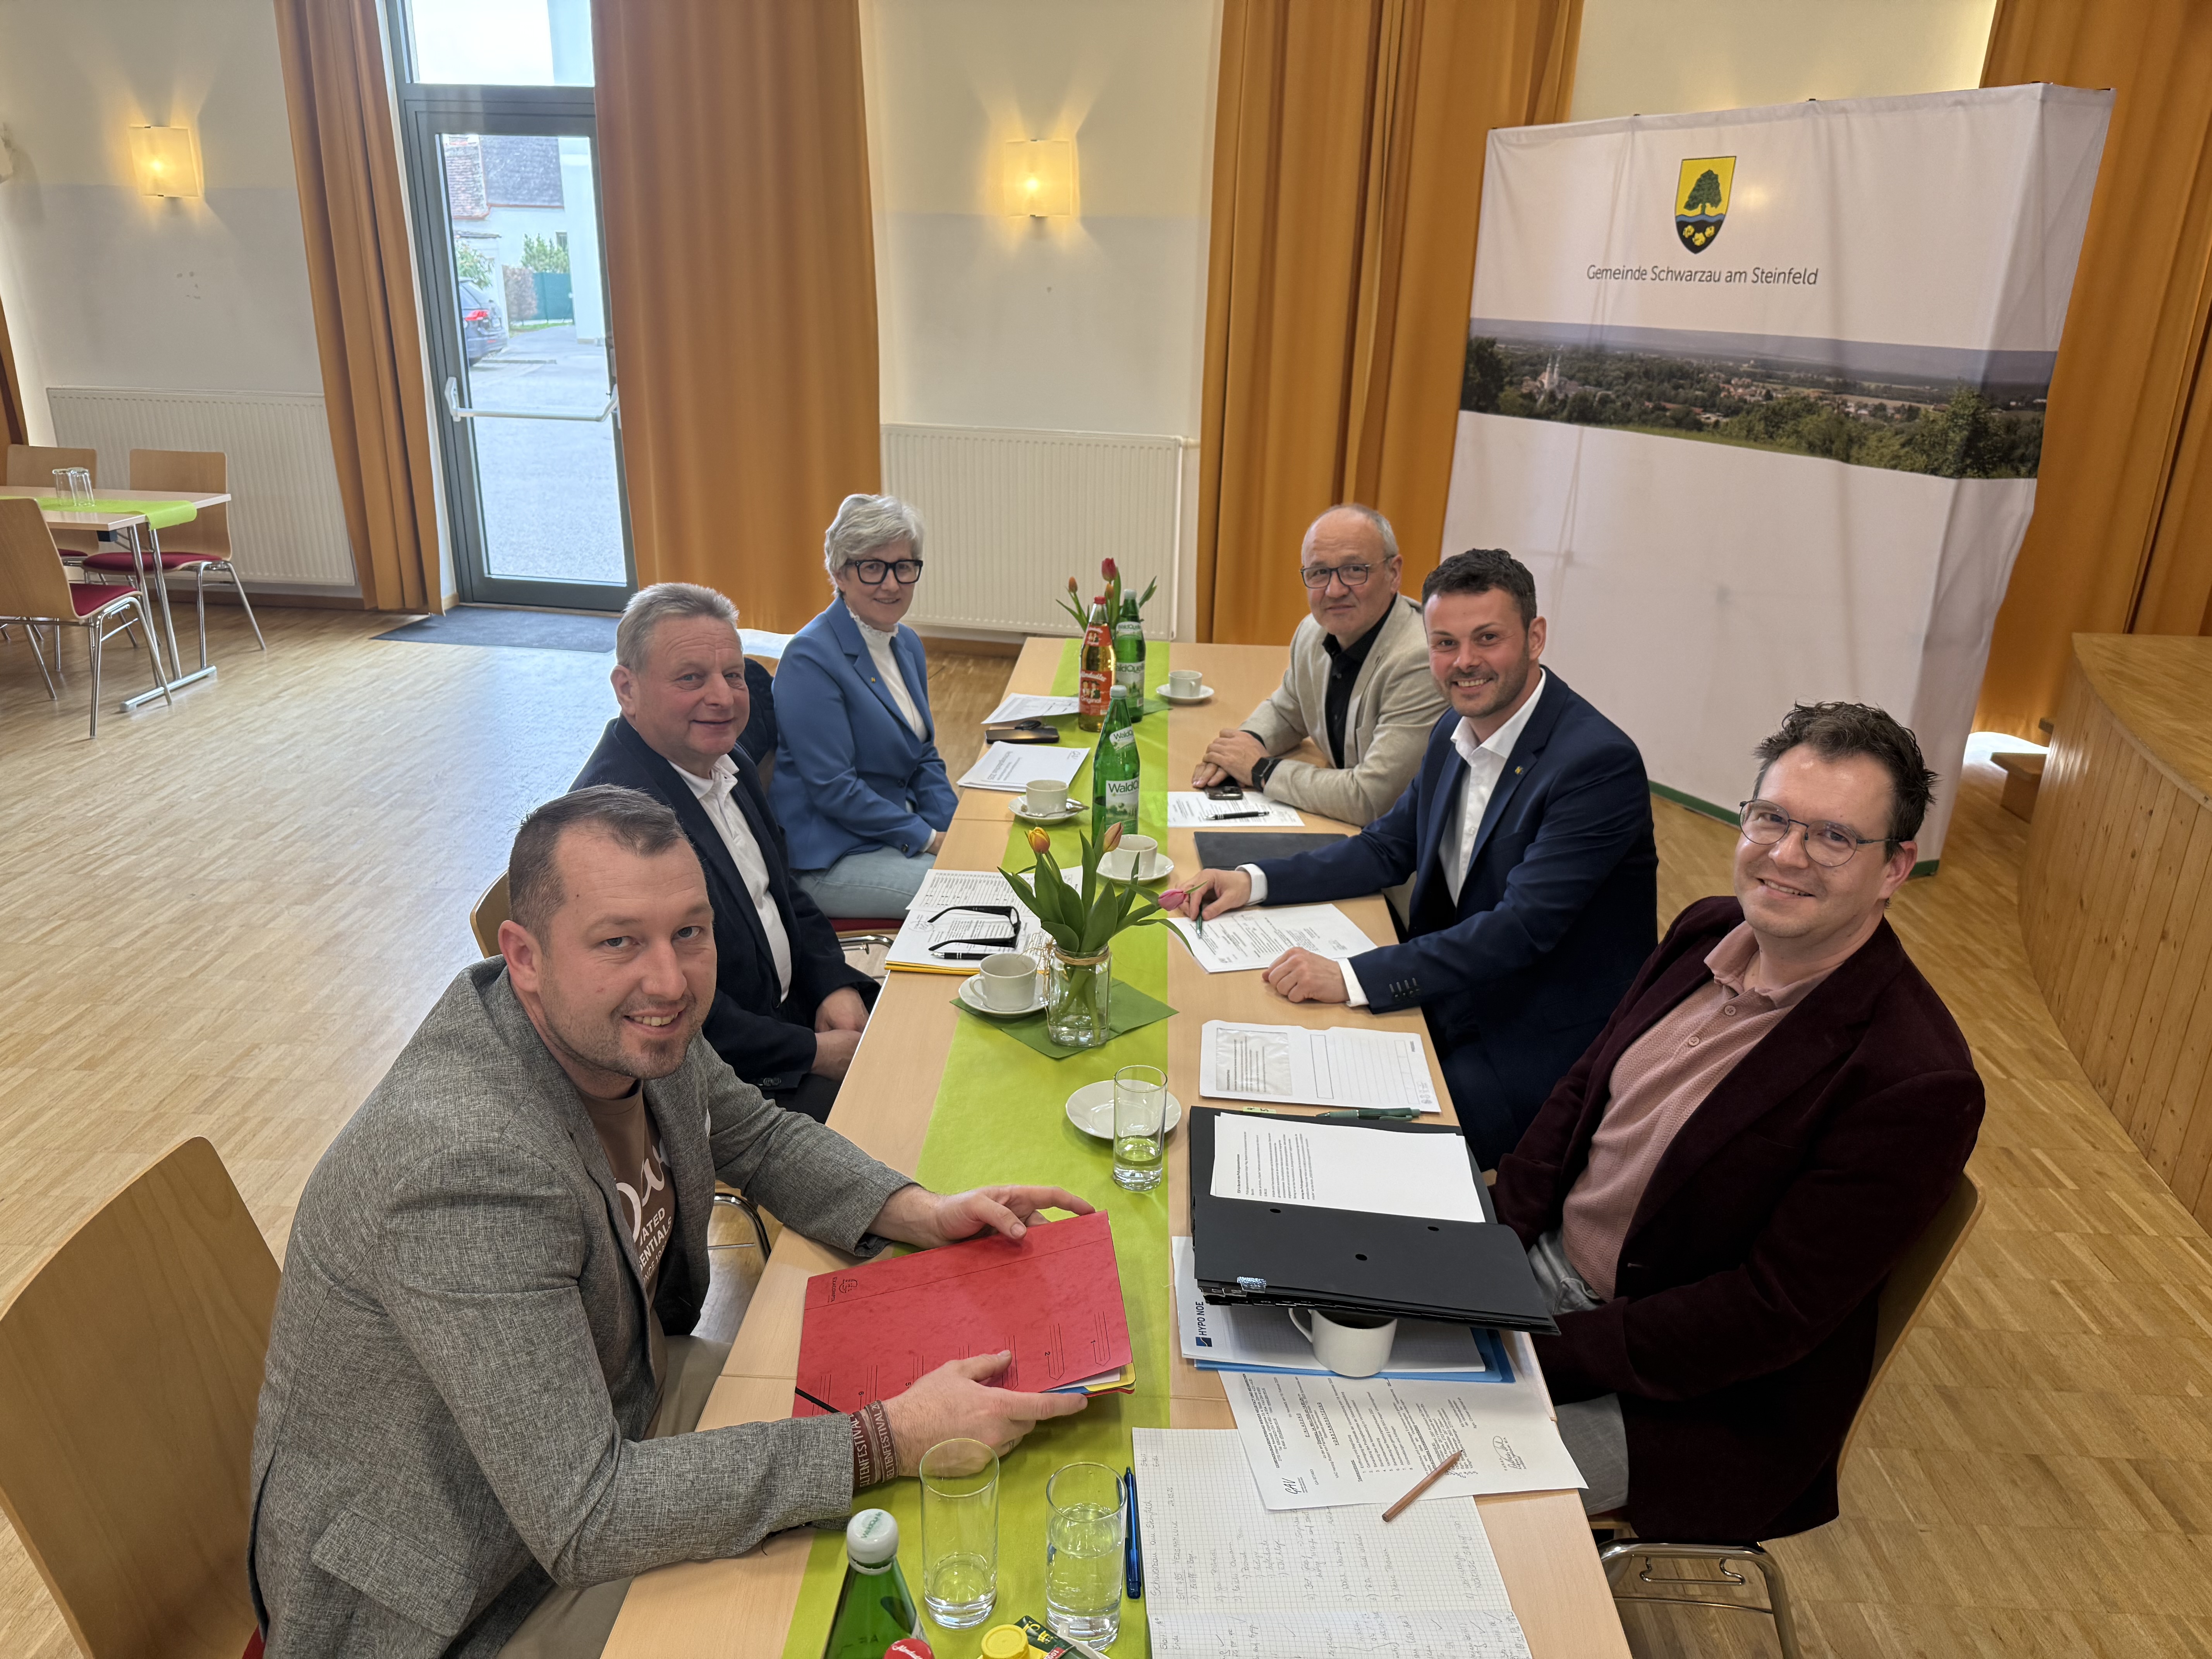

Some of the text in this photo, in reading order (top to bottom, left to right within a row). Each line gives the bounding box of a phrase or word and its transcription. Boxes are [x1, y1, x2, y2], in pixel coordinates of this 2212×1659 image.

[1587, 264, 1819, 285] Gemeinde Schwarzau am Steinfeld
[1081, 696, 1102, 704] Original
[643, 1260, 656, 1285] INCE
[1195, 1301, 1207, 1336] HYPO NOE
[851, 1417, 870, 1488] ELTENFESTIVAL
[1281, 1477, 1302, 1494] GAV
